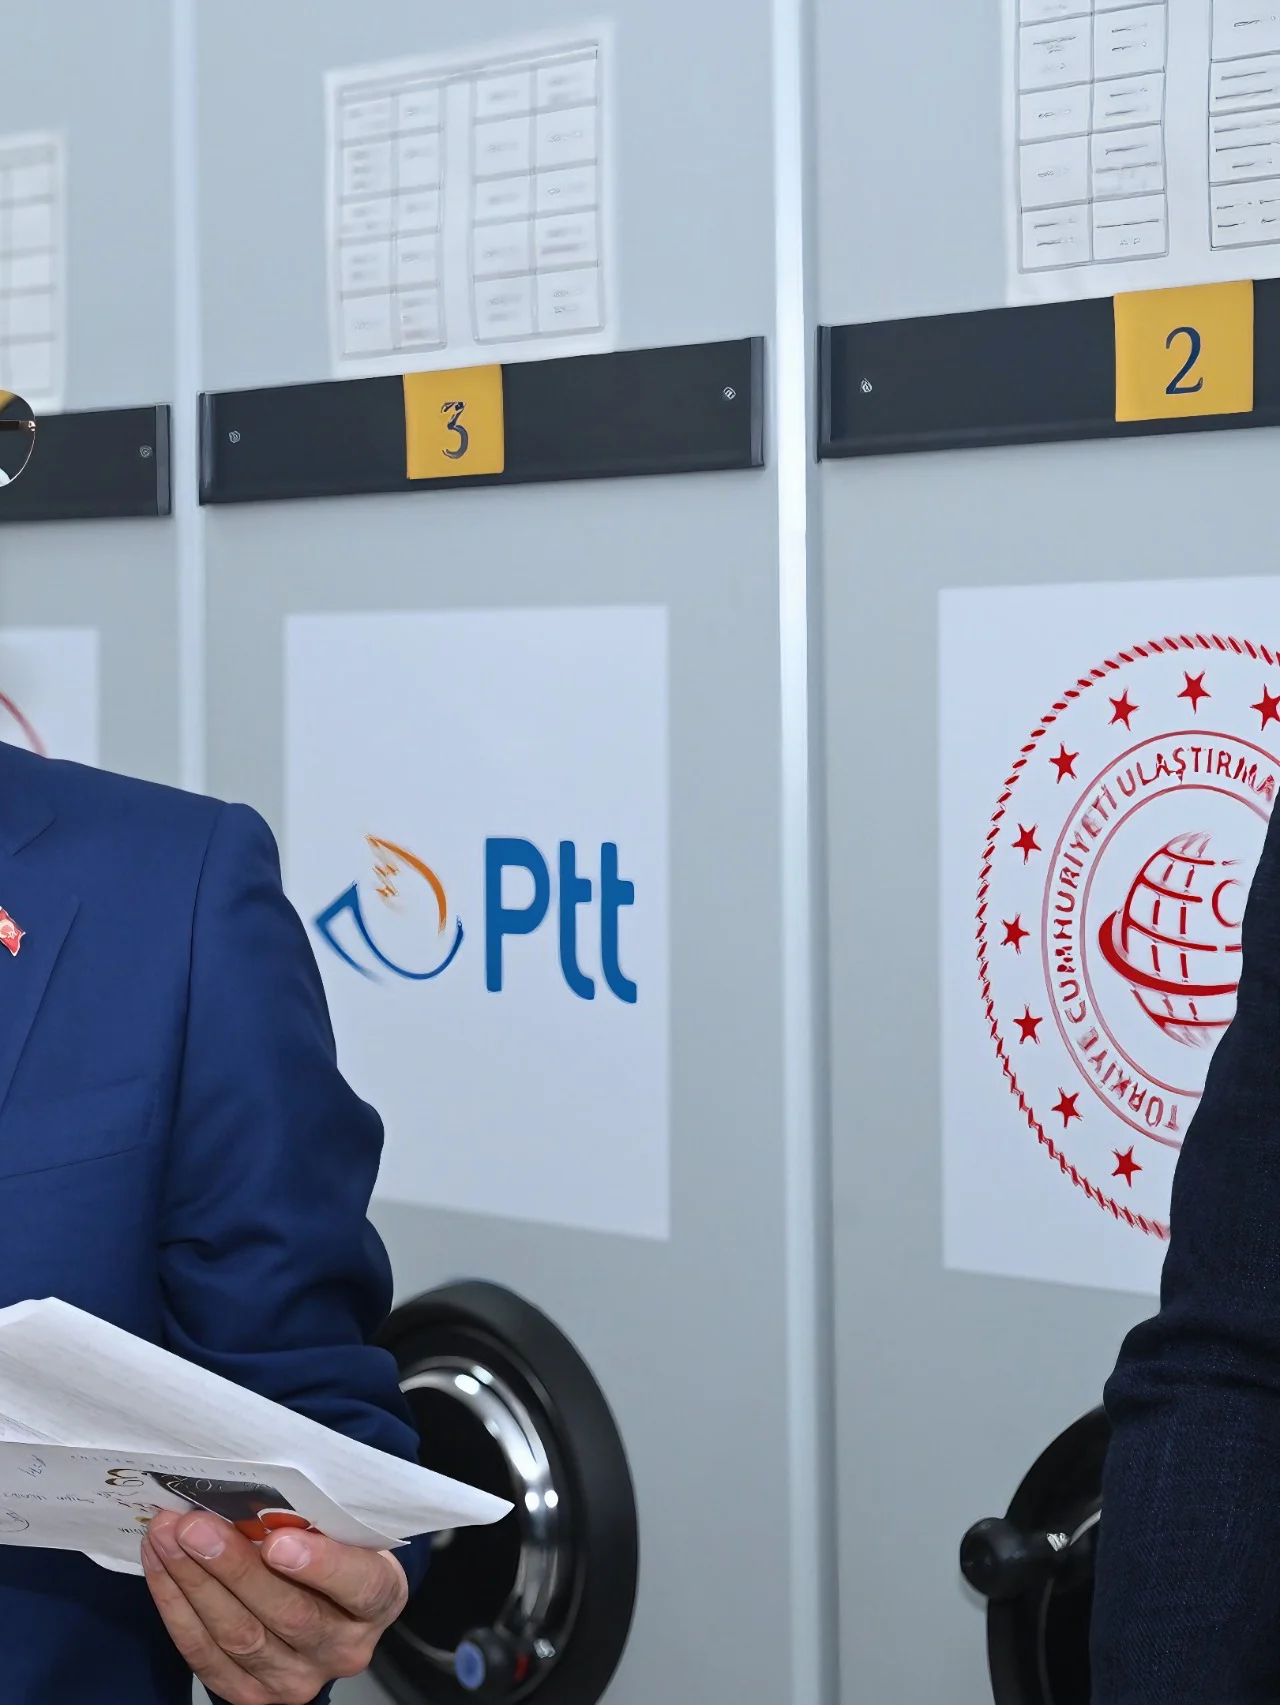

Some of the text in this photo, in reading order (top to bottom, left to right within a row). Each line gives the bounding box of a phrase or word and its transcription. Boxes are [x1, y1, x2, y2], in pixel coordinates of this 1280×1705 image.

[1165, 326, 1204, 395] 2
[440, 401, 469, 460] 3
[485, 836, 638, 1004] Ptt
